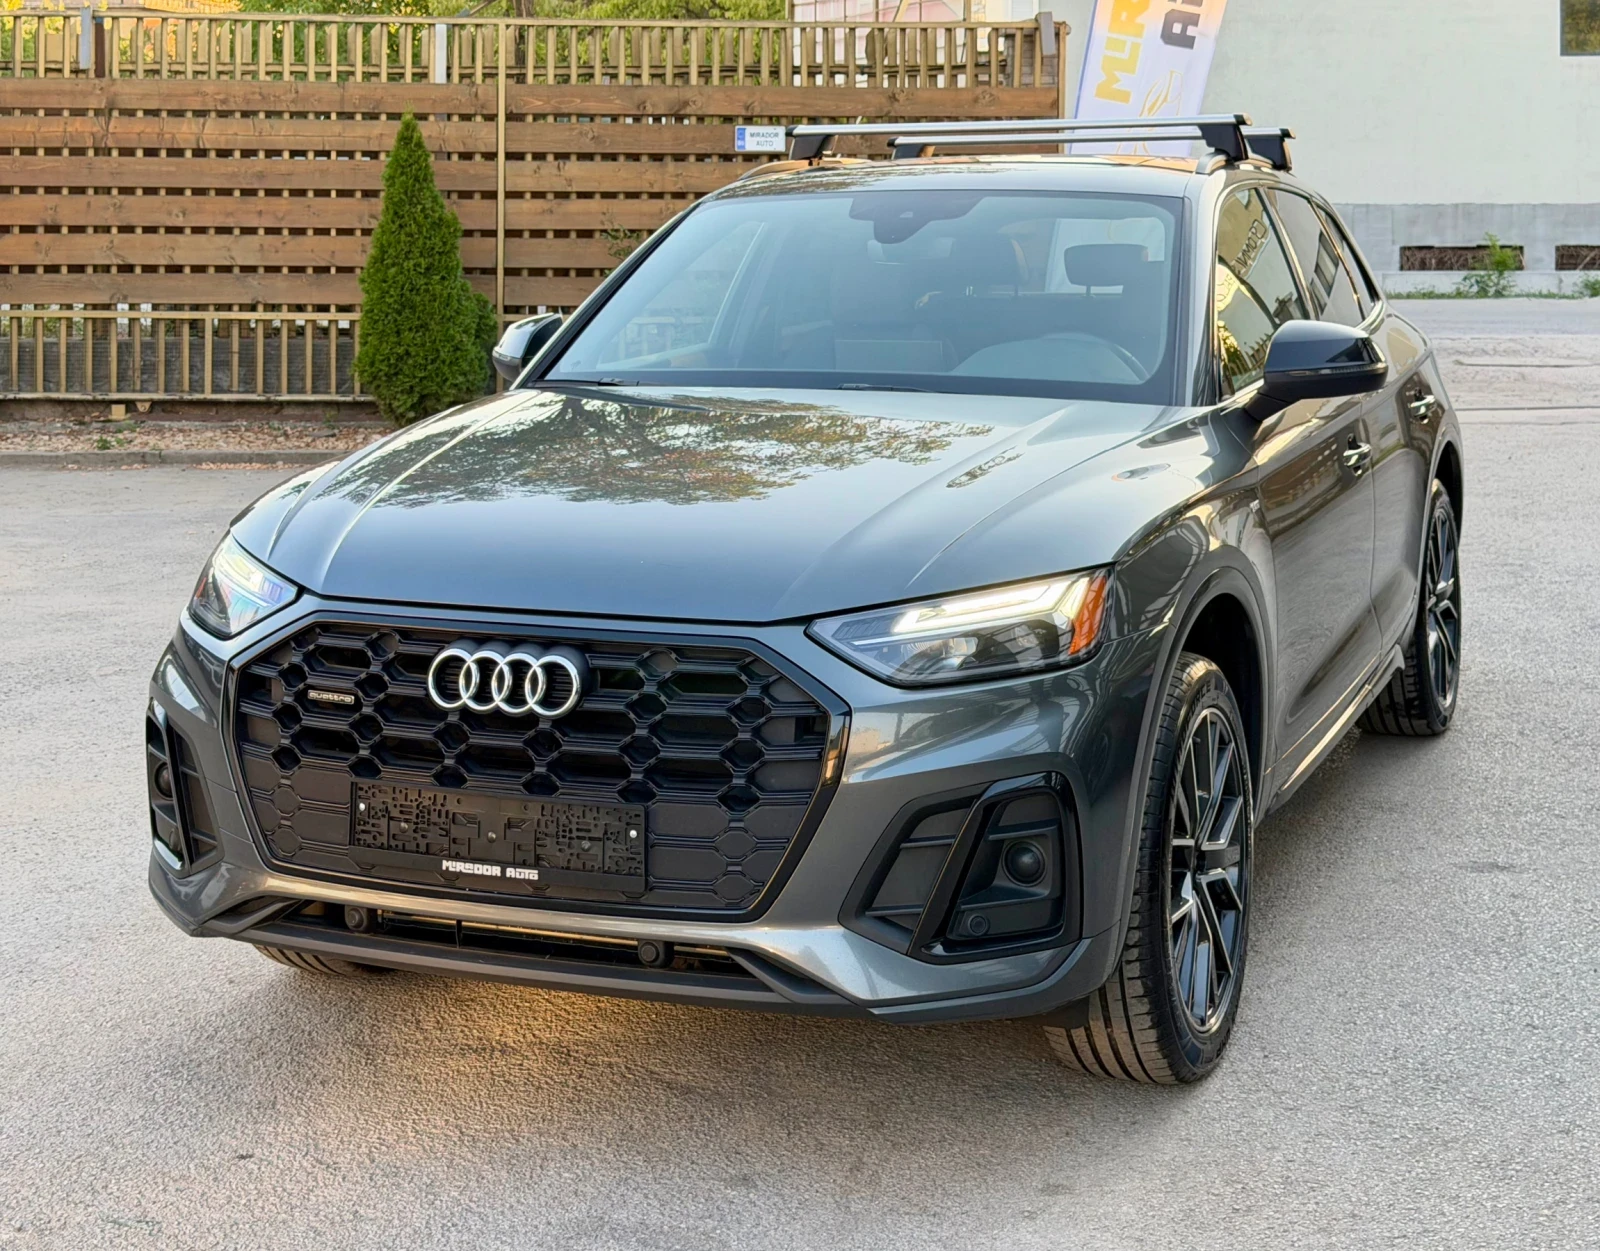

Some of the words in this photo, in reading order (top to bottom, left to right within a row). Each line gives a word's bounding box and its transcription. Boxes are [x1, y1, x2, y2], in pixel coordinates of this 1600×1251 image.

[1094, 0, 1151, 105] MIR
[750, 131, 779, 139] MIRADOR
[309, 692, 352, 703] quattro
[442, 859, 502, 877] MIRADOR
[506, 867, 539, 881] AUTO
